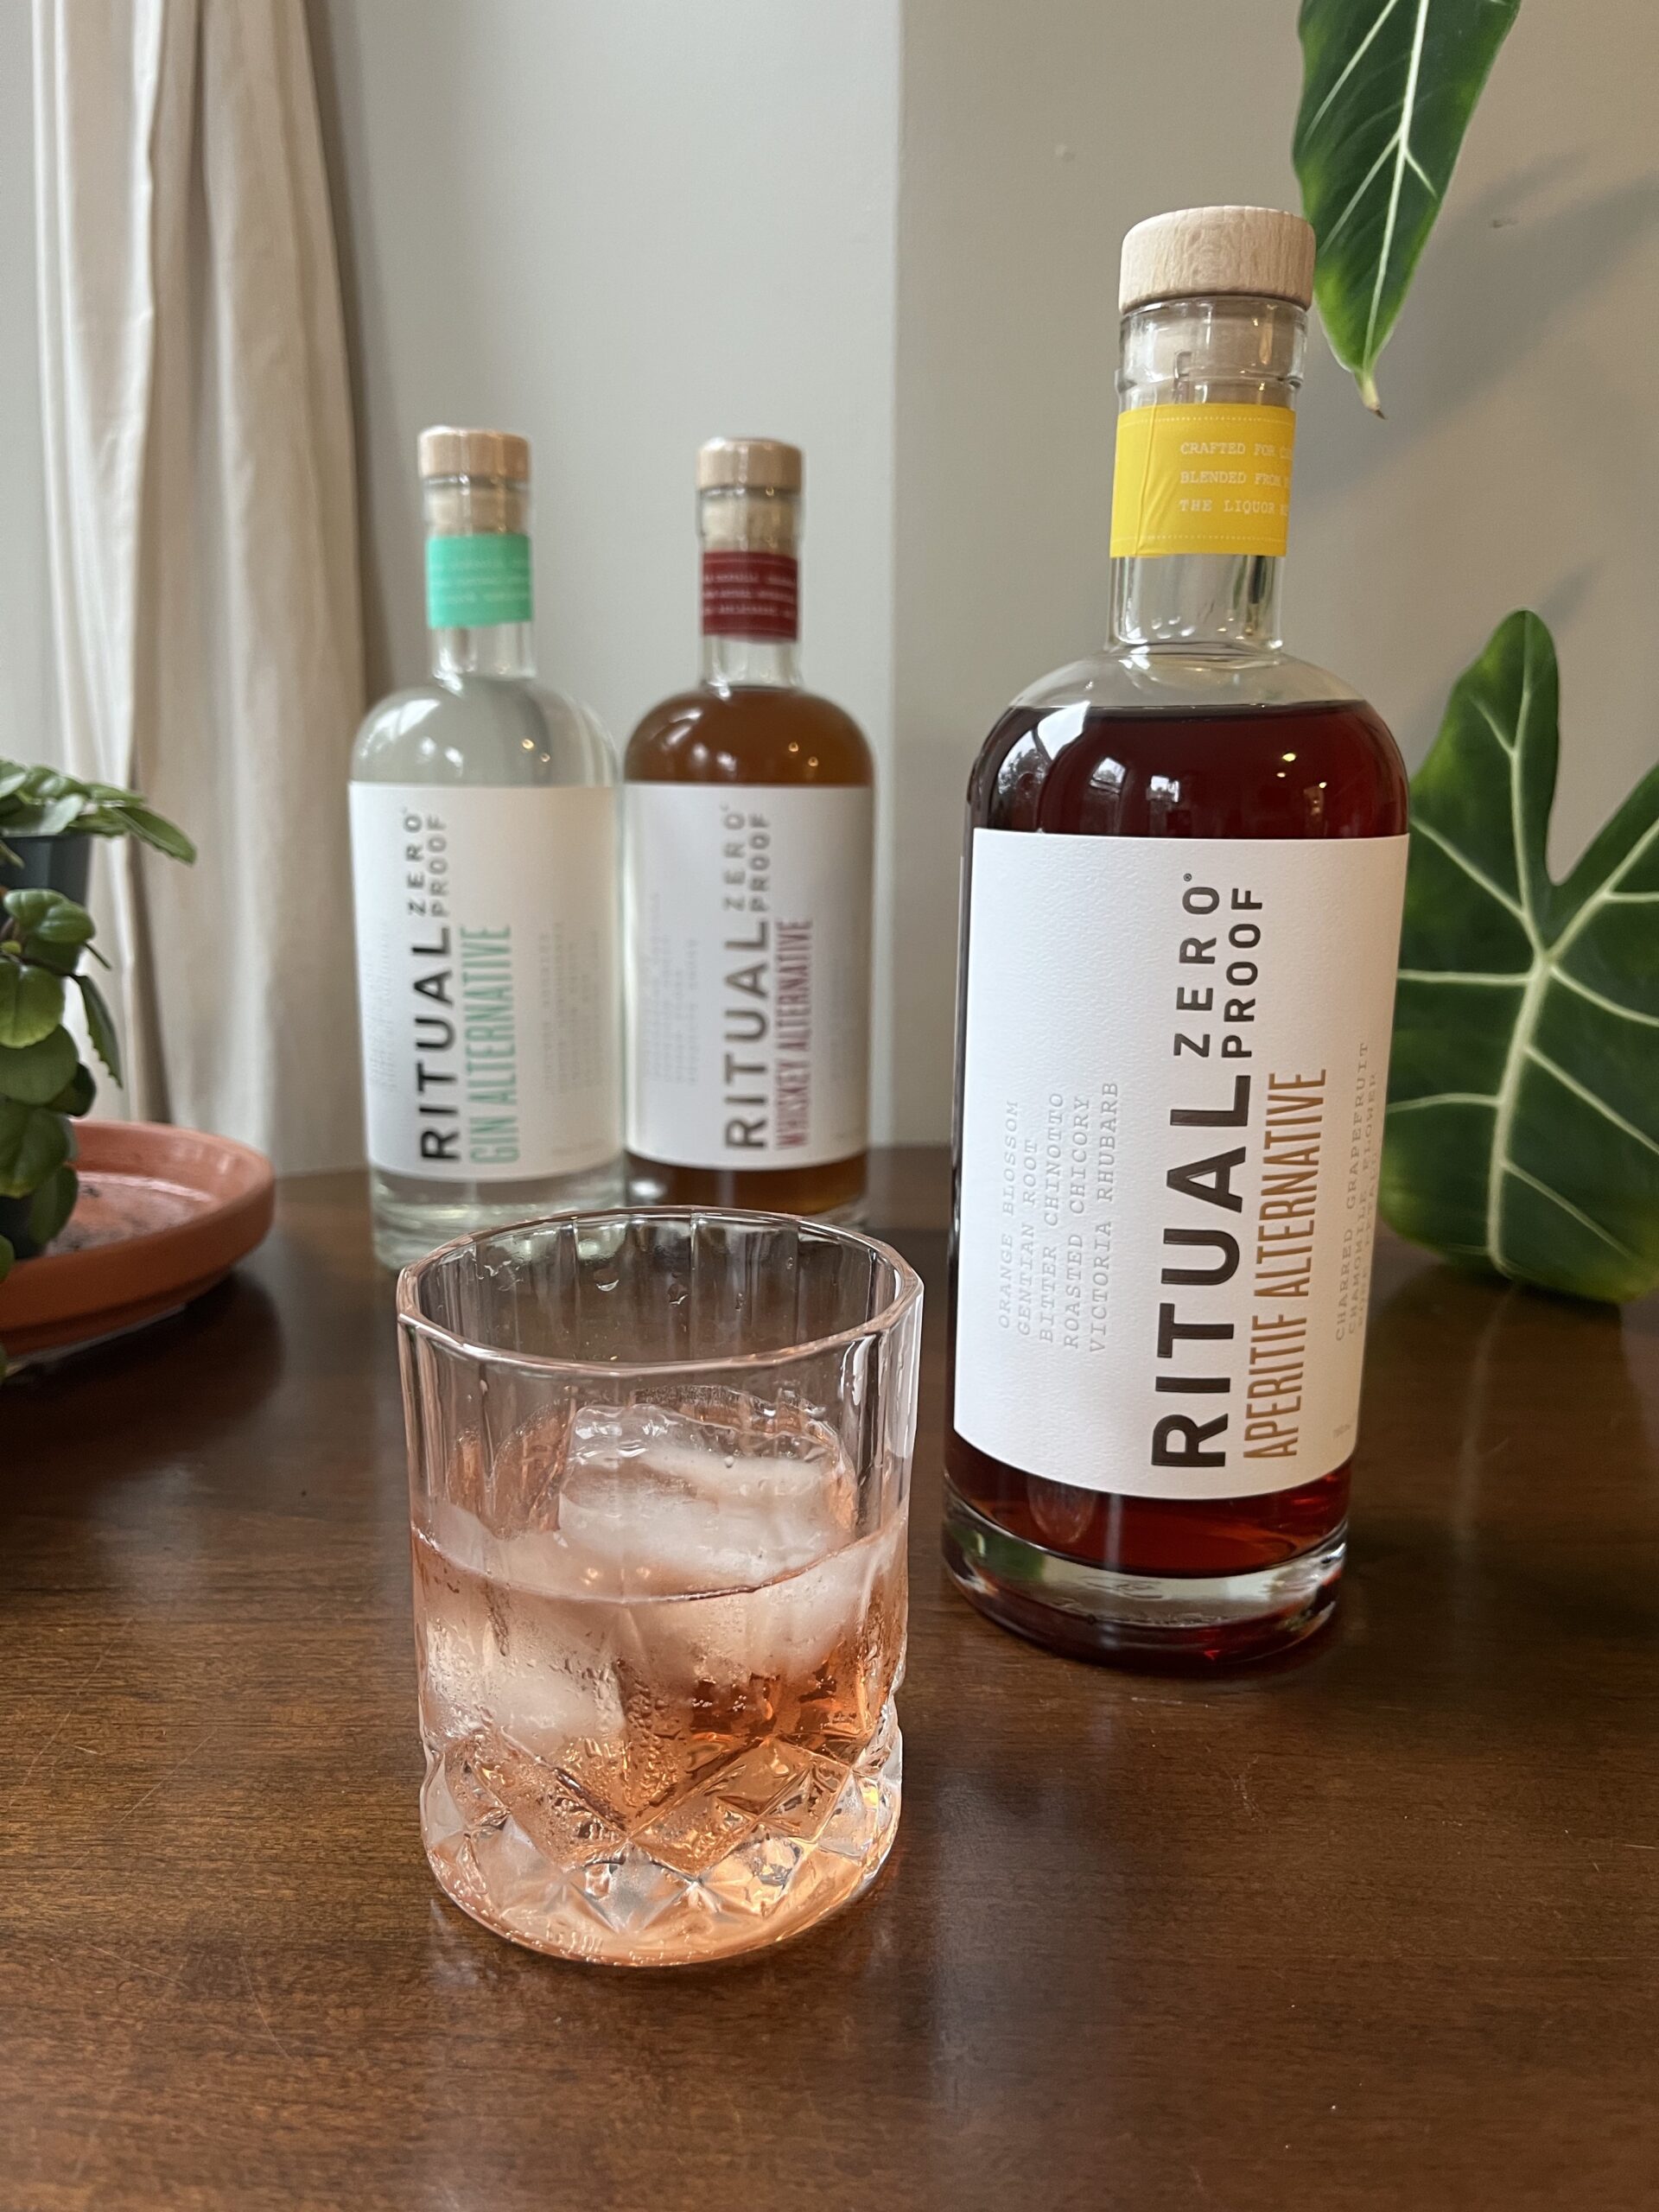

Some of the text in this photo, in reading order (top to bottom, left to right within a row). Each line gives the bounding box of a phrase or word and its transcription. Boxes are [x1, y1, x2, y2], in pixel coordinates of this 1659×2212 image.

[1179, 500, 1213, 512] THE
[1224, 501, 1274, 514] LIQUOR
[1180, 442, 1245, 454] CRAFTED
[1255, 444, 1275, 456] FOR
[1180, 472, 1246, 484] BLENDED
[403, 812, 426, 917] ZERO
[427, 812, 449, 918] PROOF
[721, 812, 746, 912] ZERO
[748, 812, 771, 912] PROOF
[1221, 887, 1264, 1058] PROOF
[410, 926, 459, 1163] RITUAL
[460, 925, 520, 1164] GIN ALTERNATIVE
[723, 919, 769, 1150] RITUAL
[774, 919, 812, 1149] WHISKEY ALTERNATIVE
[998, 1100, 1018, 1329] ORANGE BLOSSOM
[1017, 1139, 1038, 1336] GENTIAN ROOT
[1039, 1092, 1064, 1343] BITTER CHINOTTO
[1064, 1096, 1090, 1349] ROASTED CHICORY
[1090, 1082, 1118, 1353] VICTORIA RHUBARB
[1151, 1074, 1252, 1469] RITUAL
[1243, 1069, 1327, 1459] APERITIF ALTERNATIVE
[1335, 1040, 1370, 1342] CHARRED GRAPEFRUIT
